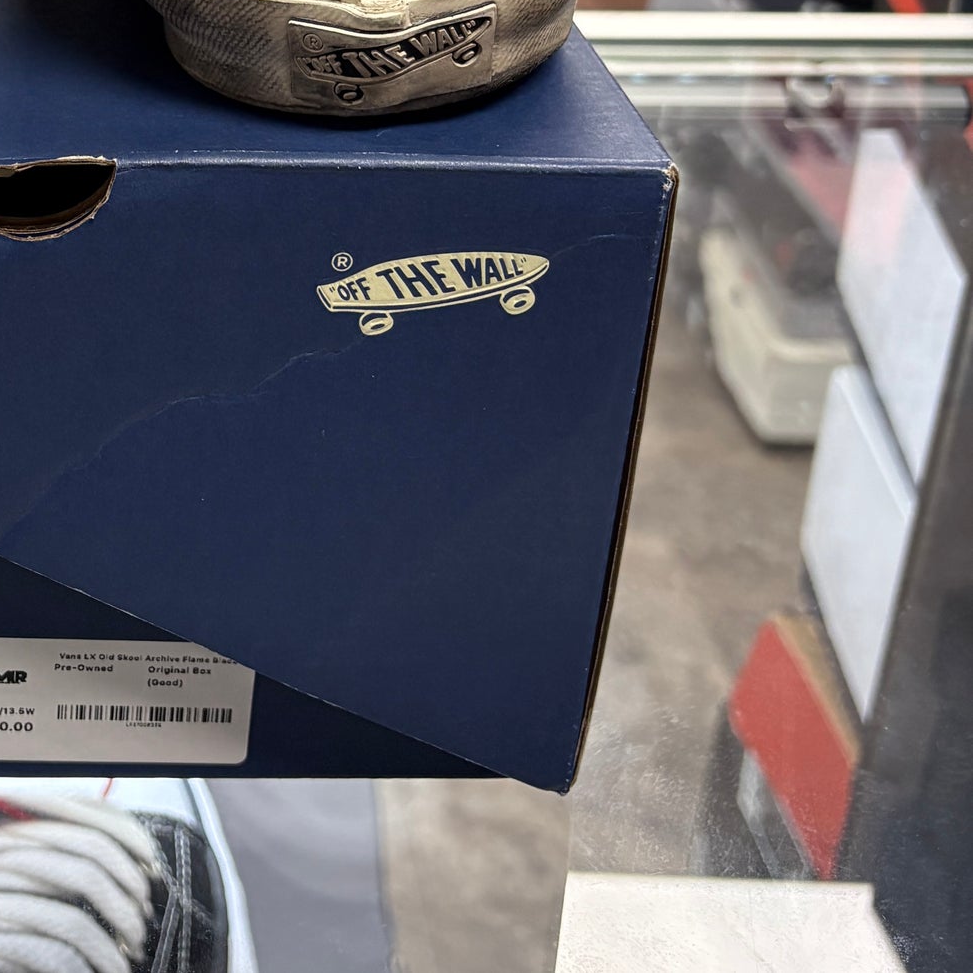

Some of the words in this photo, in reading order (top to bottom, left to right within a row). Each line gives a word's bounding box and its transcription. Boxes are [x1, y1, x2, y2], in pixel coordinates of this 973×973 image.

[342, 44, 416, 77] THE
[377, 260, 456, 299] THE
[145, 655, 180, 663] Archive
[182, 655, 210, 664] Flame
[54, 663, 114, 673] Pre-Owned
[148, 666, 190, 675] Original
[192, 667, 212, 675] Box
[147, 678, 183, 688] (Good)
